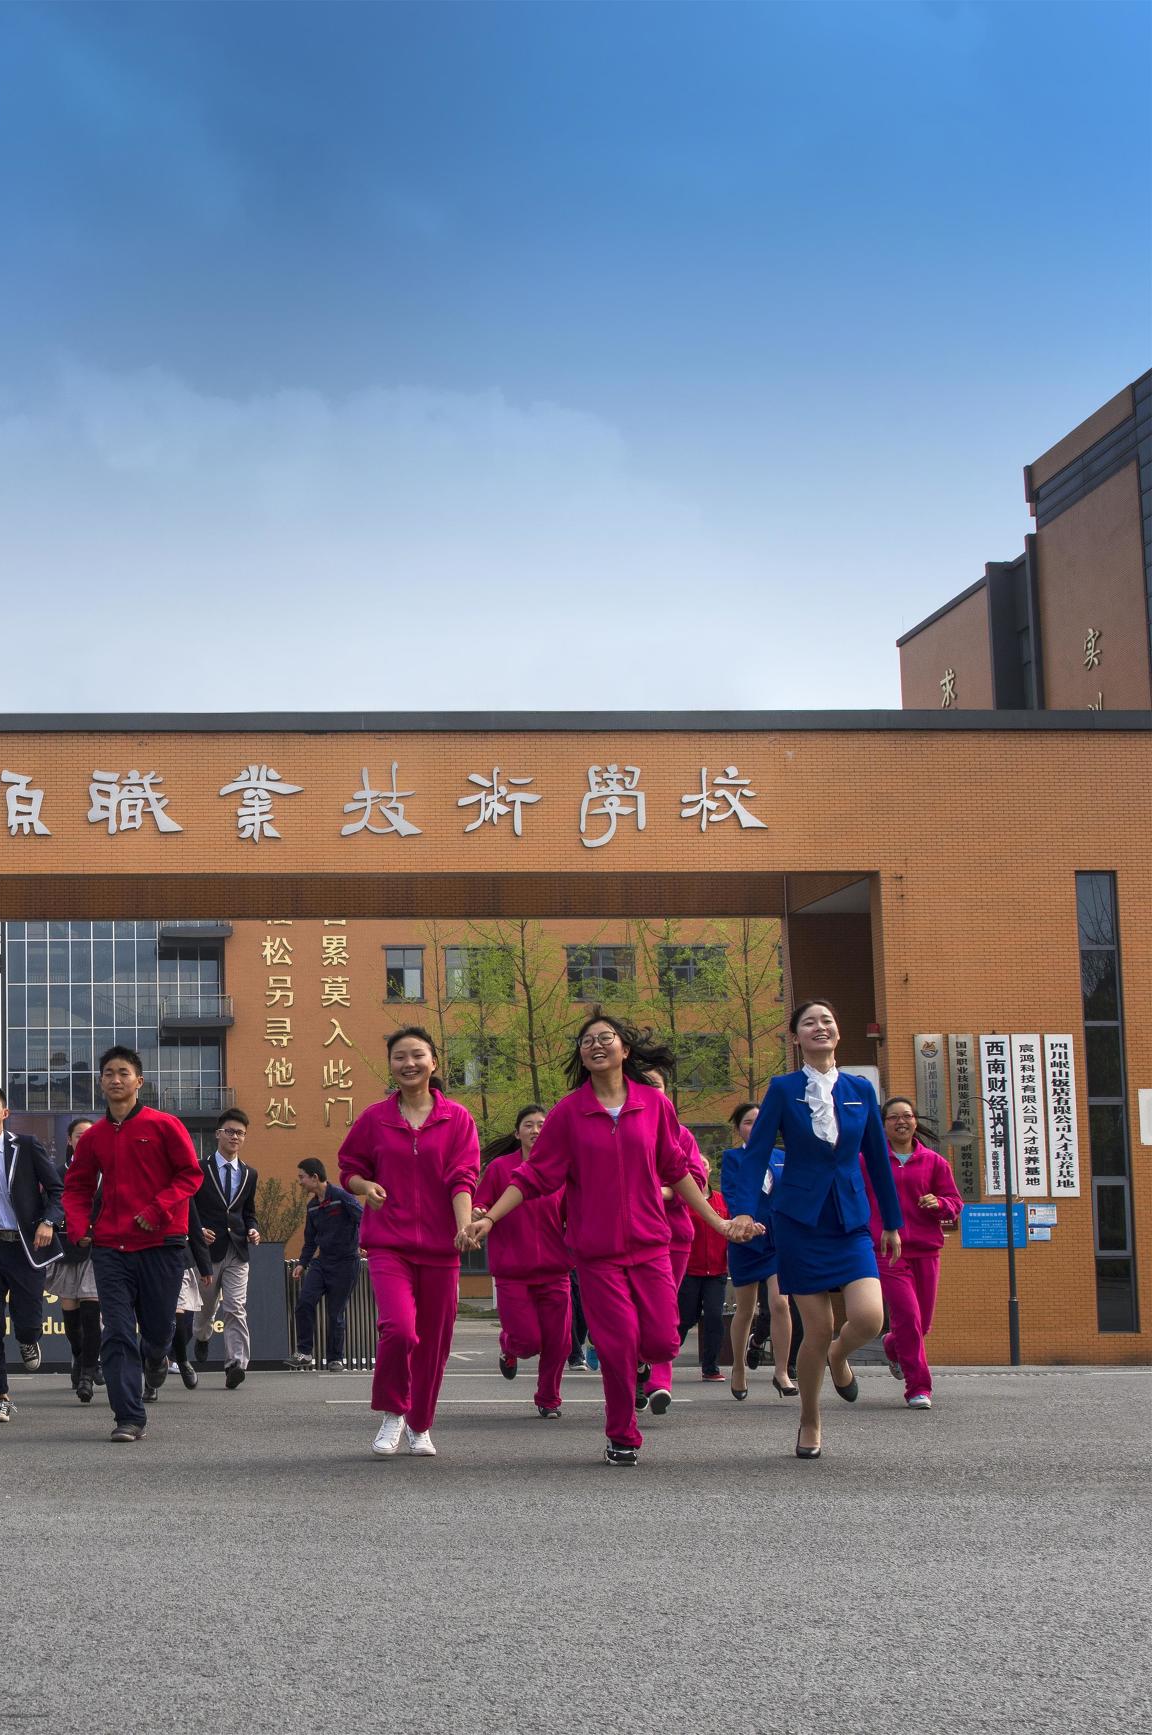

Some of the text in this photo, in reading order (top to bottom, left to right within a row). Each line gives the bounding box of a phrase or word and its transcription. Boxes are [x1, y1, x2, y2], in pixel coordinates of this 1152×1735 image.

[261, 920, 297, 1129] 松另寻他处
[320, 920, 353, 1127] 累莫入此门
[1019, 1044, 1040, 1186] 宸鸿科技有限公司人才培养基地
[1050, 1042, 1076, 1189] 四川岷山饭店有限公司人才培养基地
